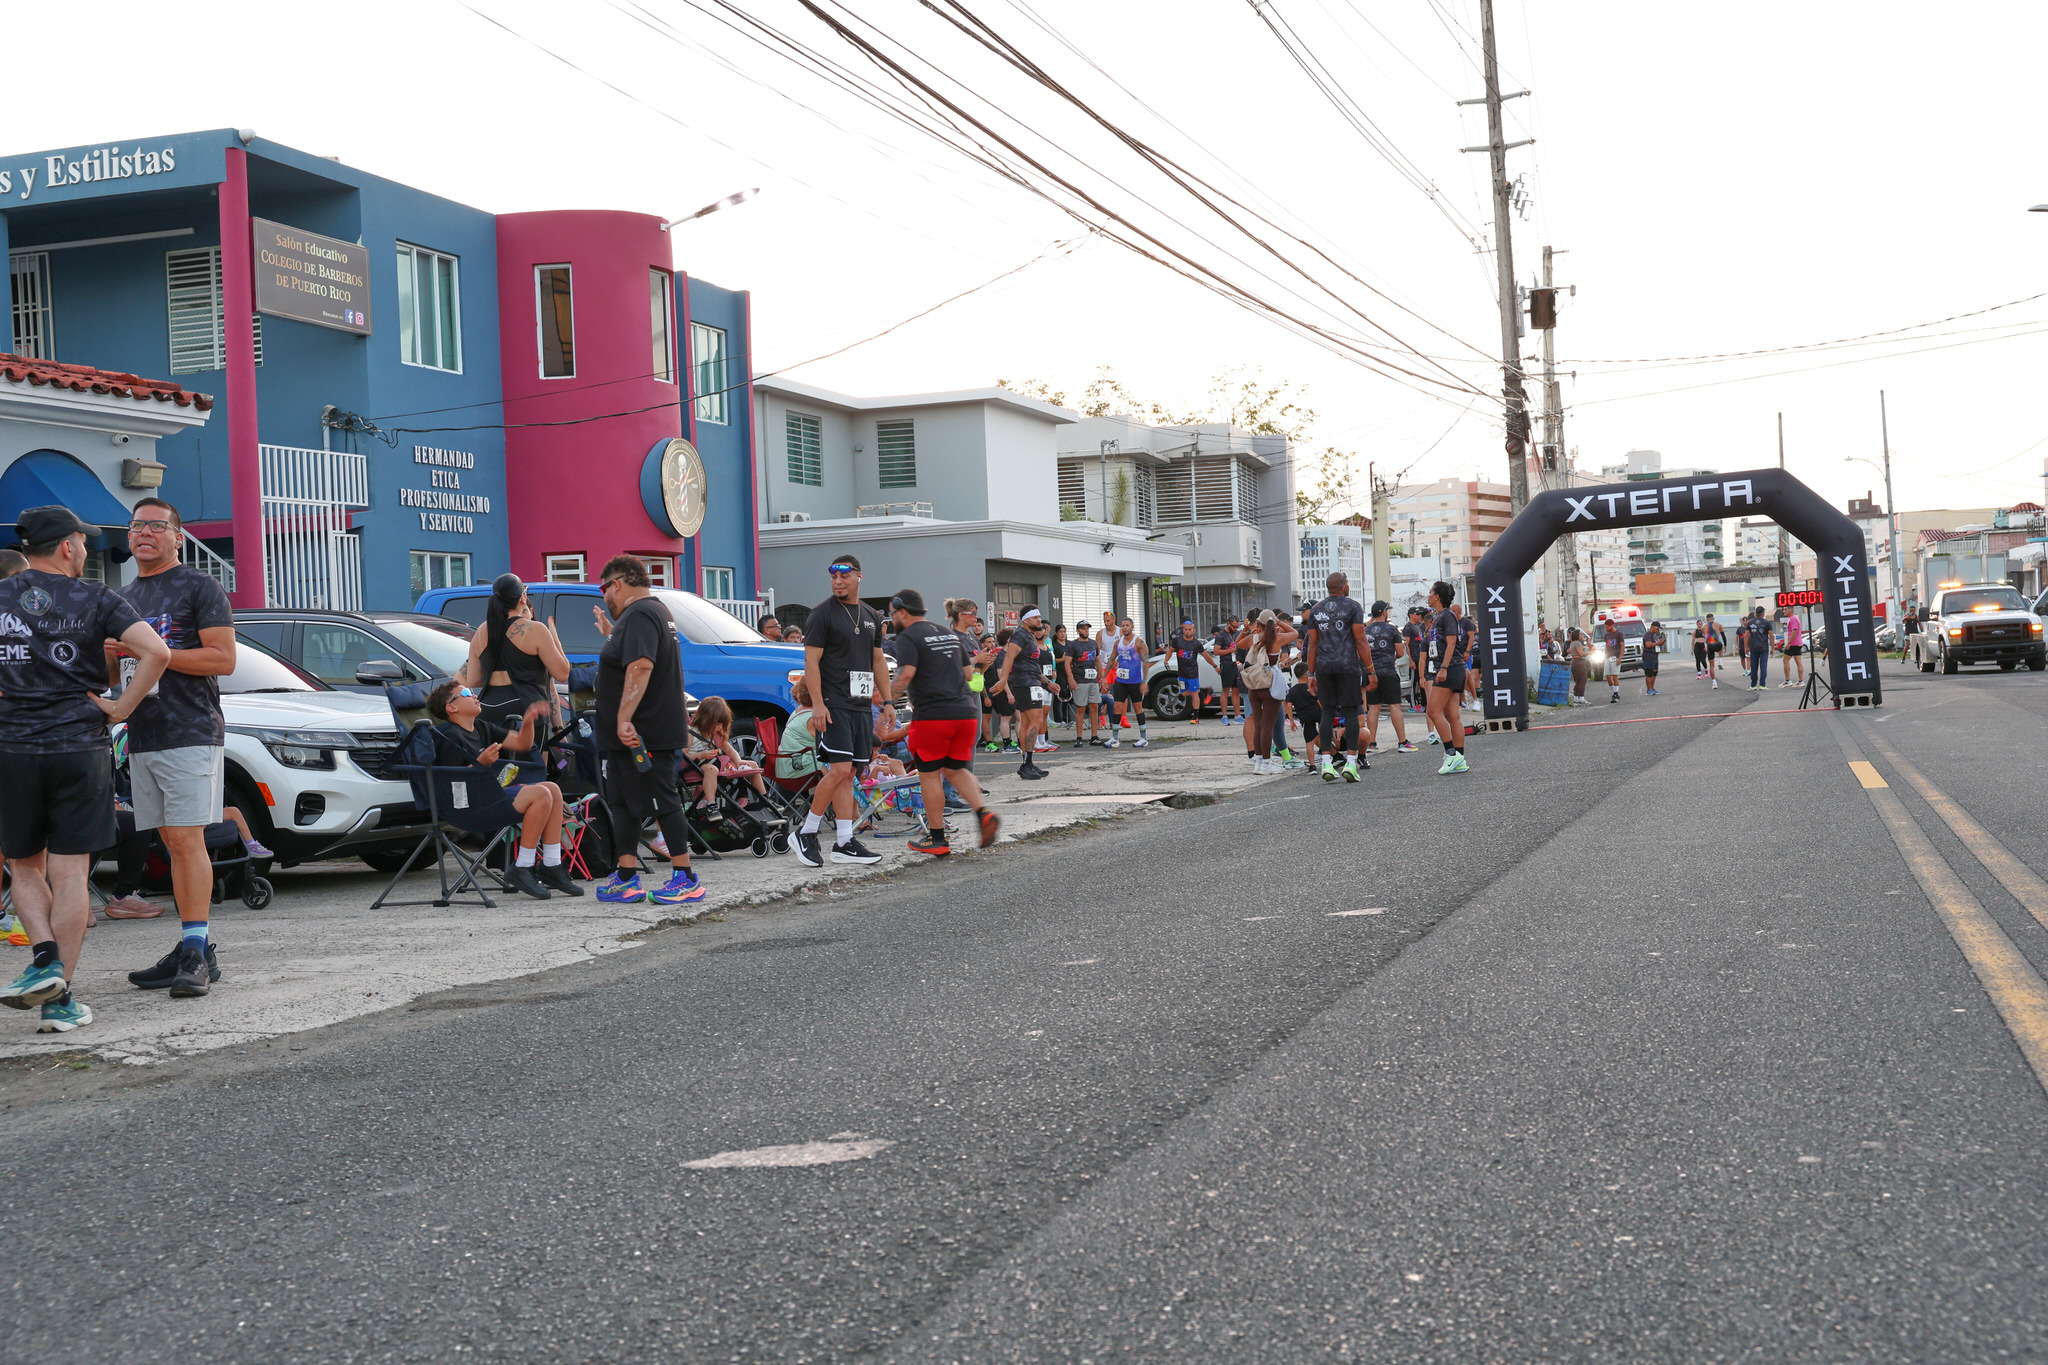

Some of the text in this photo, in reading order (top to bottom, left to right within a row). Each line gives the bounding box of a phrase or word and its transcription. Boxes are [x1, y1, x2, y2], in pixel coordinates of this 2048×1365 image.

[20, 167, 38, 199] y
[44, 147, 176, 188] Estilistas
[275, 234, 348, 264] Salón Educativo
[261, 249, 363, 288] COLEGIO DE BARBEROS
[275, 273, 351, 303] DE PUERTO RICO
[414, 445, 474, 469] HERMANDAD
[431, 469, 460, 489] ETICA
[400, 487, 490, 514] PROFESIONALISMO
[420, 512, 474, 534] Y SERVICIO
[1052, 597, 1060, 609] 31
[860, 683, 870, 695] 21
